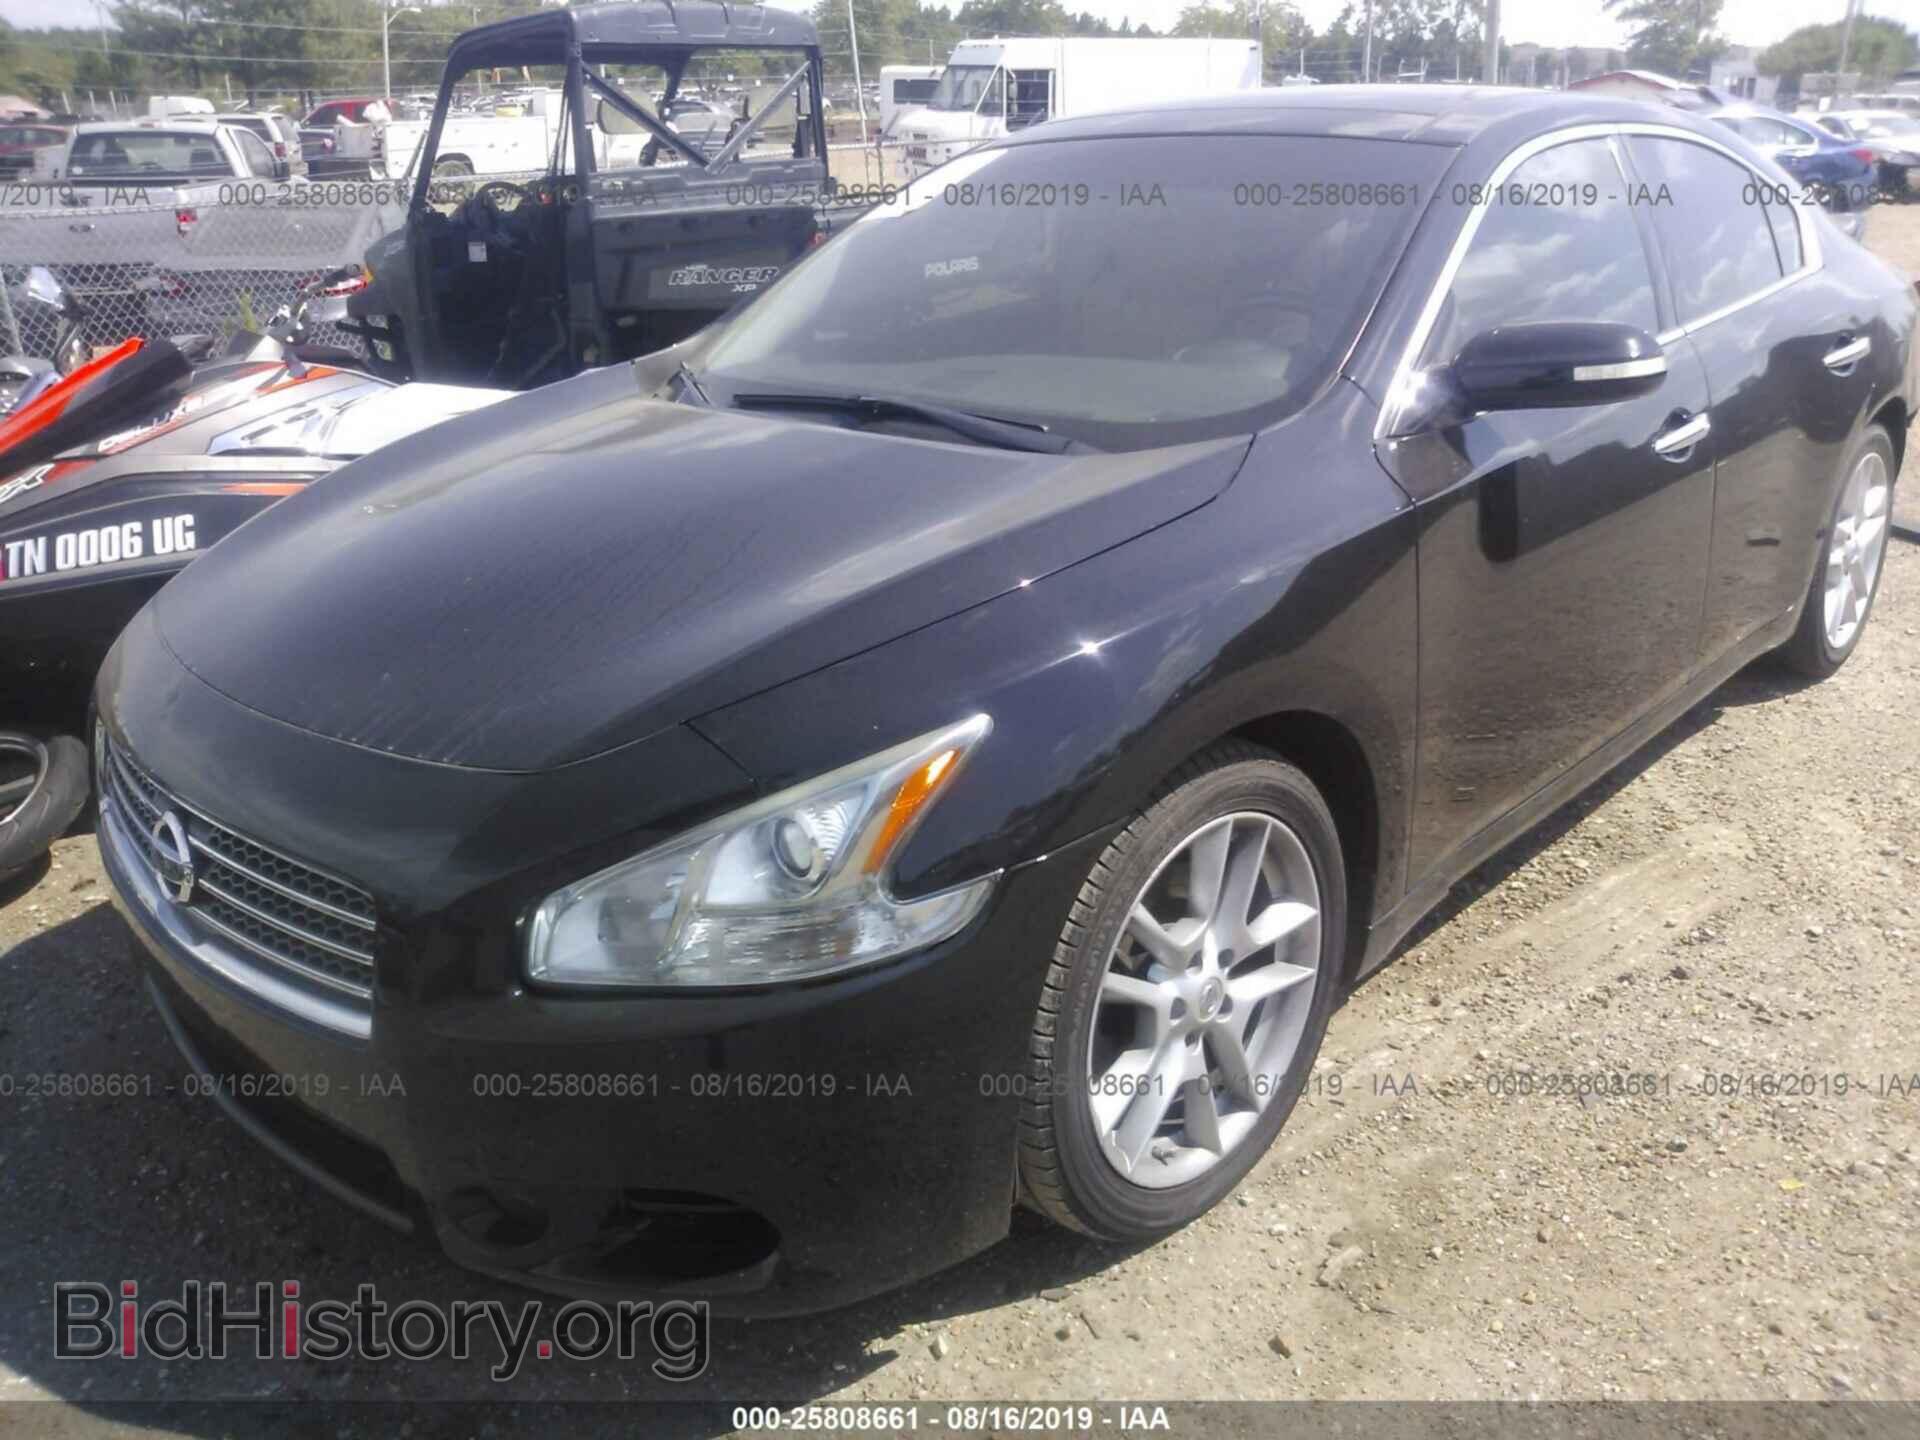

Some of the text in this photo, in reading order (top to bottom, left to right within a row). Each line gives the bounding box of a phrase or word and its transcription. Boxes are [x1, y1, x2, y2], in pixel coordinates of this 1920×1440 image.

[668, 265, 780, 286] RANGER
[731, 283, 757, 292] XP
[5, 514, 196, 578] TN 0006 UG
